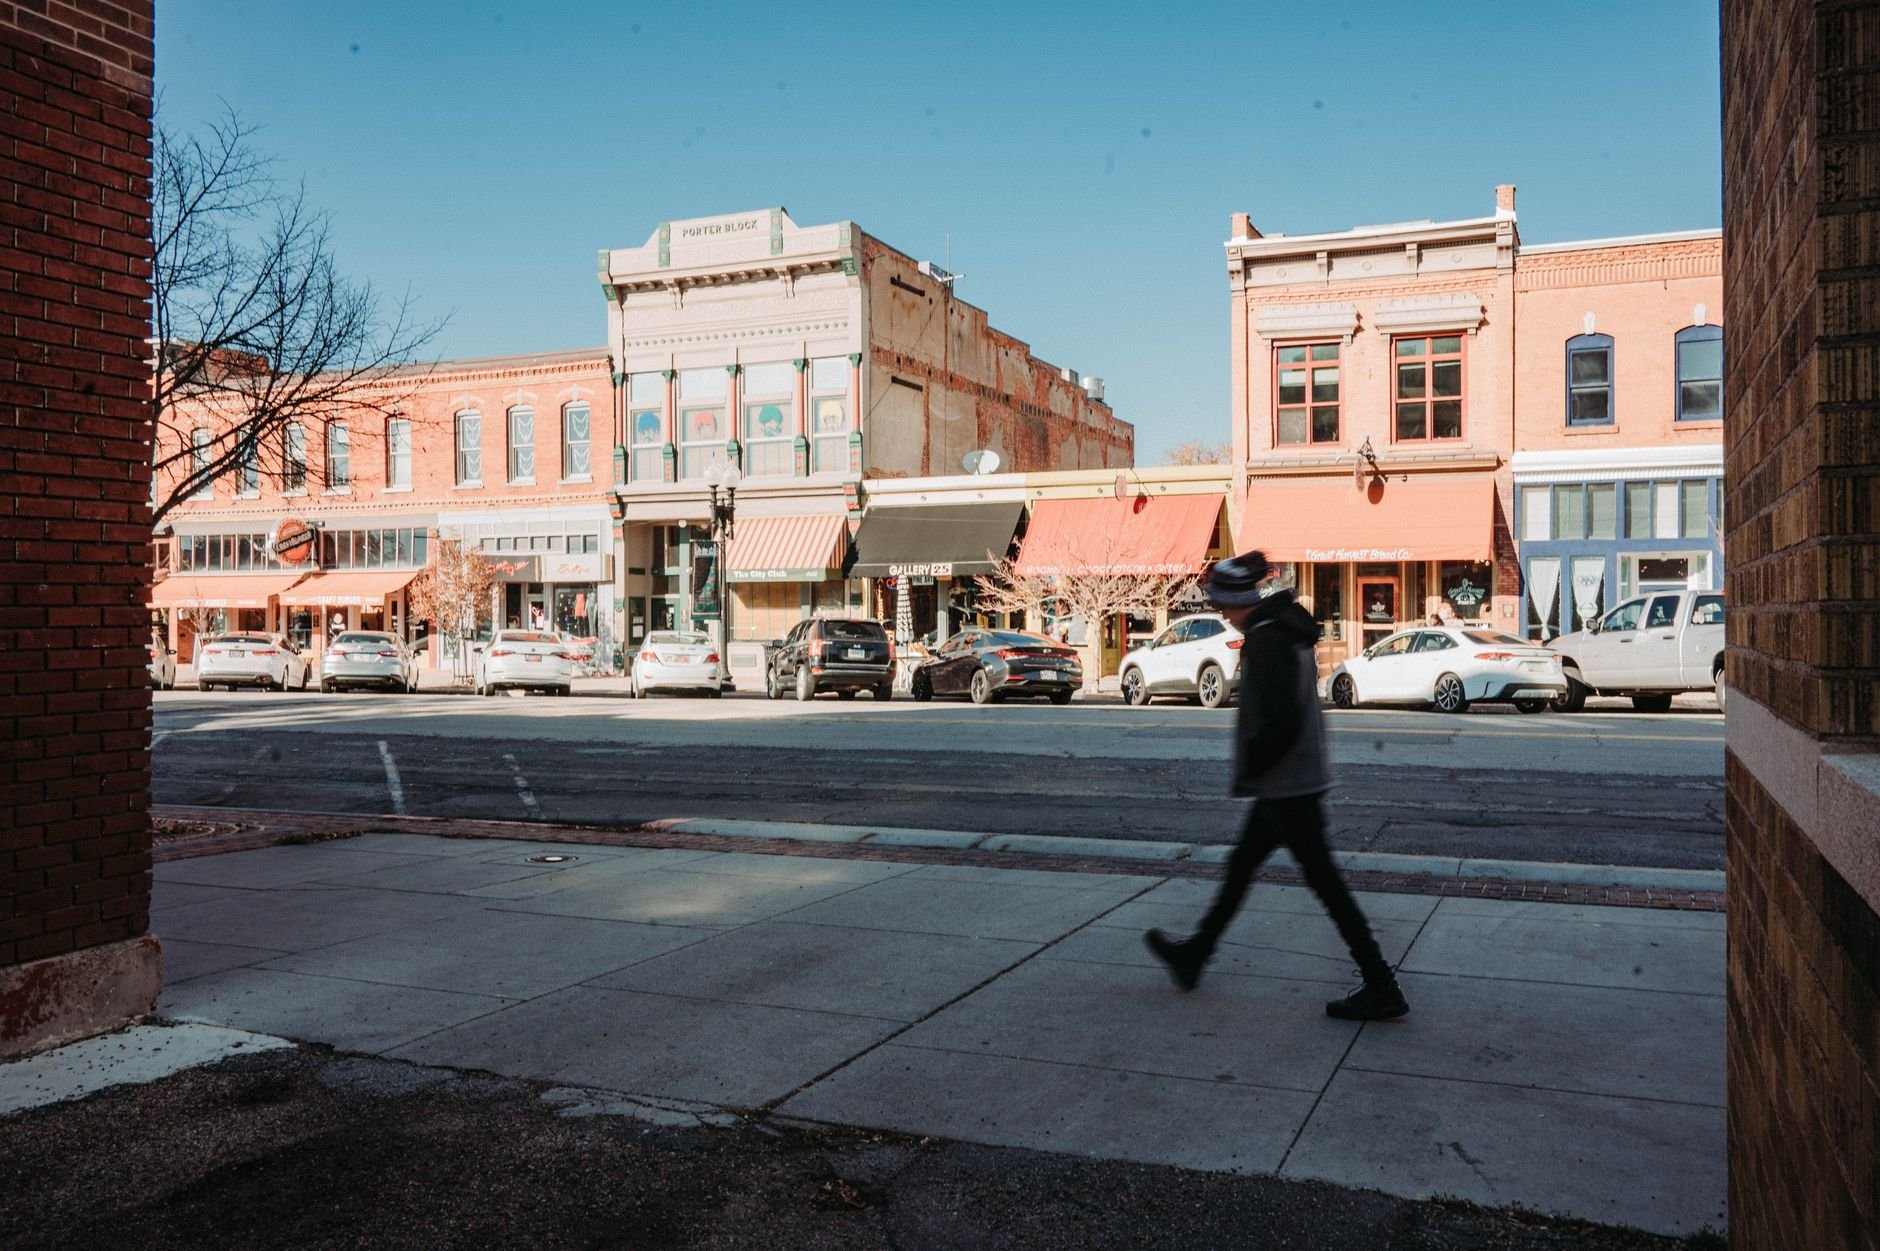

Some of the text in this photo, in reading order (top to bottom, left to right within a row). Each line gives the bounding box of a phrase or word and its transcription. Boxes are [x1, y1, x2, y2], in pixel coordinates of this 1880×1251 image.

[682, 219, 758, 238] PORTER BLOCK
[1370, 549, 1397, 560] Bread
[750, 571, 766, 579] City
[767, 570, 787, 578] Club
[889, 564, 949, 576] GALLERY 25
